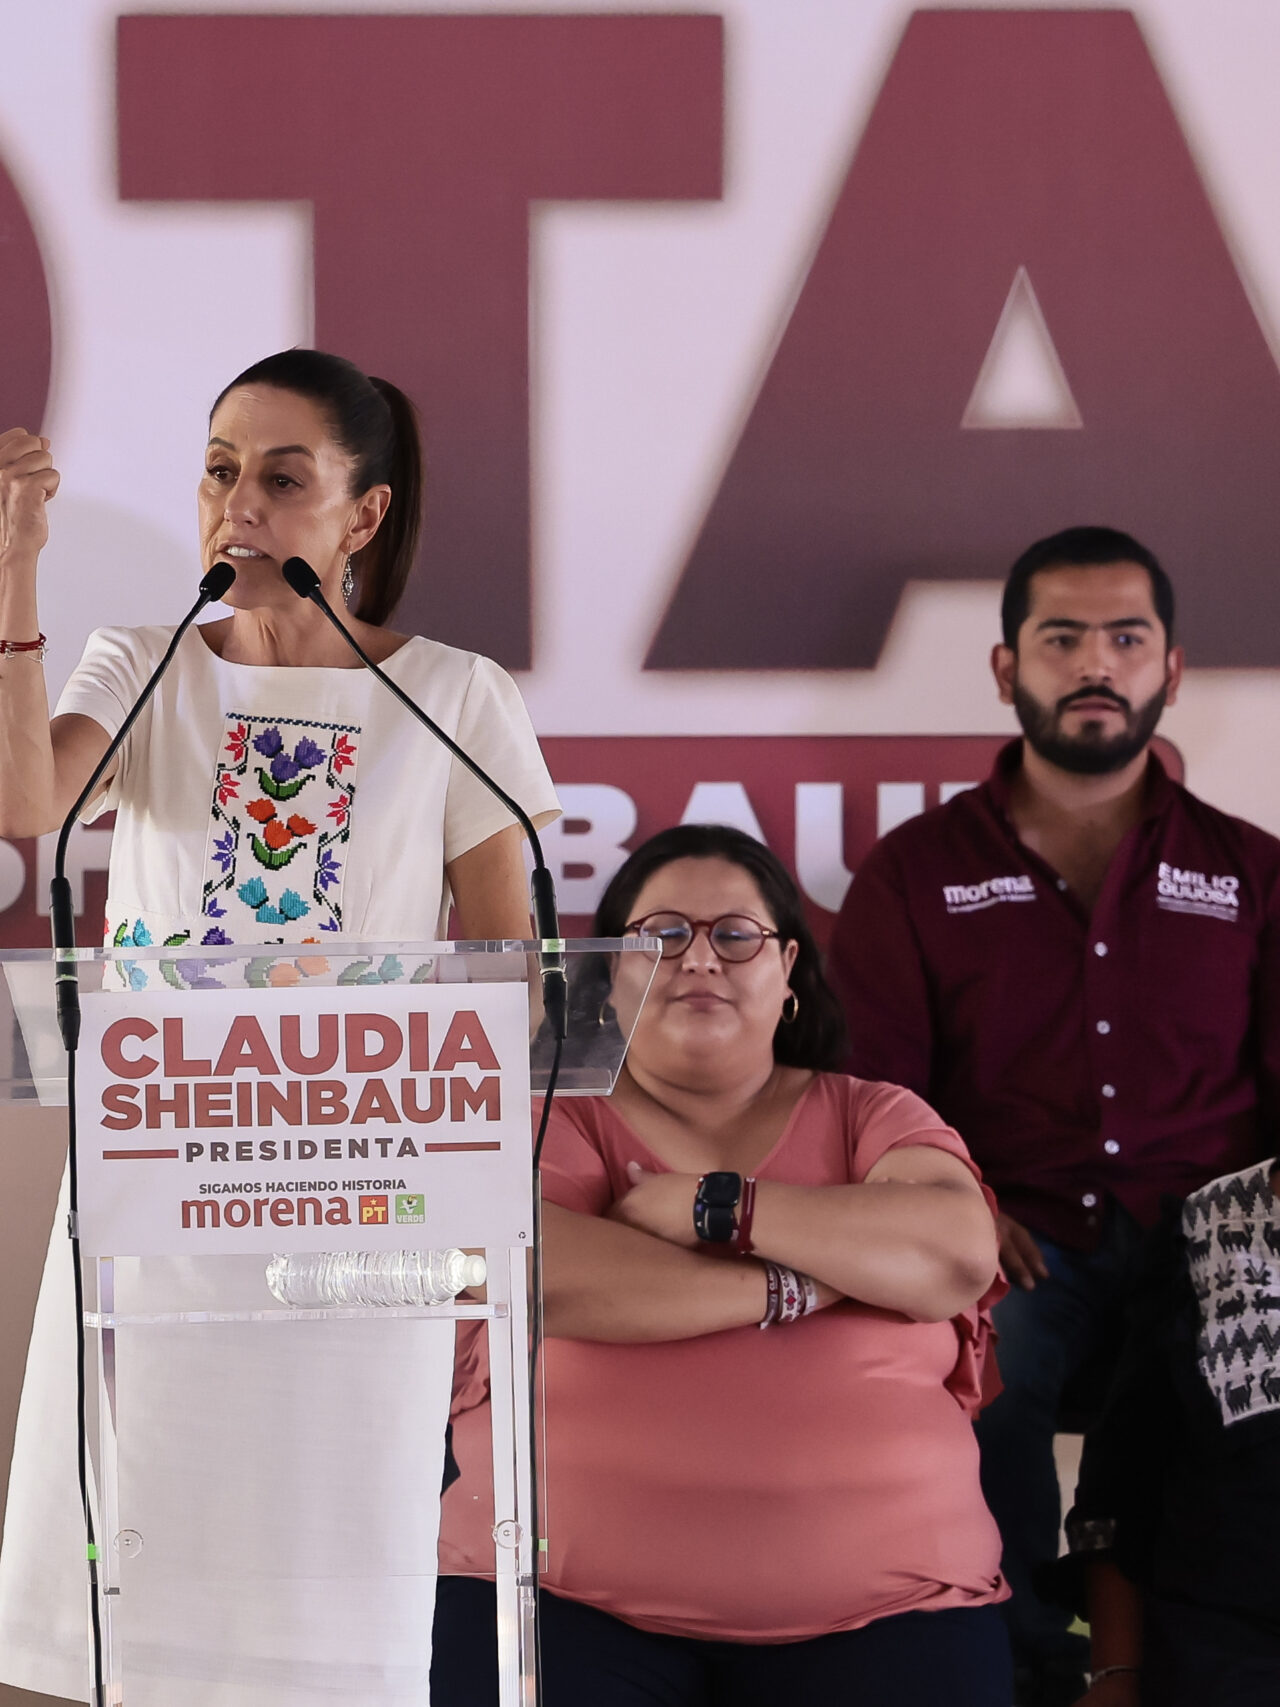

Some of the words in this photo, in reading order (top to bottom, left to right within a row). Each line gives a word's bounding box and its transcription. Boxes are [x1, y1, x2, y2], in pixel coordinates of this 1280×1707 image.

[943, 875, 1034, 904] morena
[100, 1010, 501, 1080] CLAUDIA
[100, 1076, 501, 1131] SHEINBAUM
[185, 1137, 419, 1163] PRESIDENTA
[199, 1182, 262, 1194] SIGAMOS
[266, 1180, 338, 1193] HACIENDO
[342, 1179, 406, 1191] HISTORIA
[181, 1196, 351, 1228] morena
[362, 1206, 386, 1223] PT
[397, 1214, 424, 1223] VERDE
